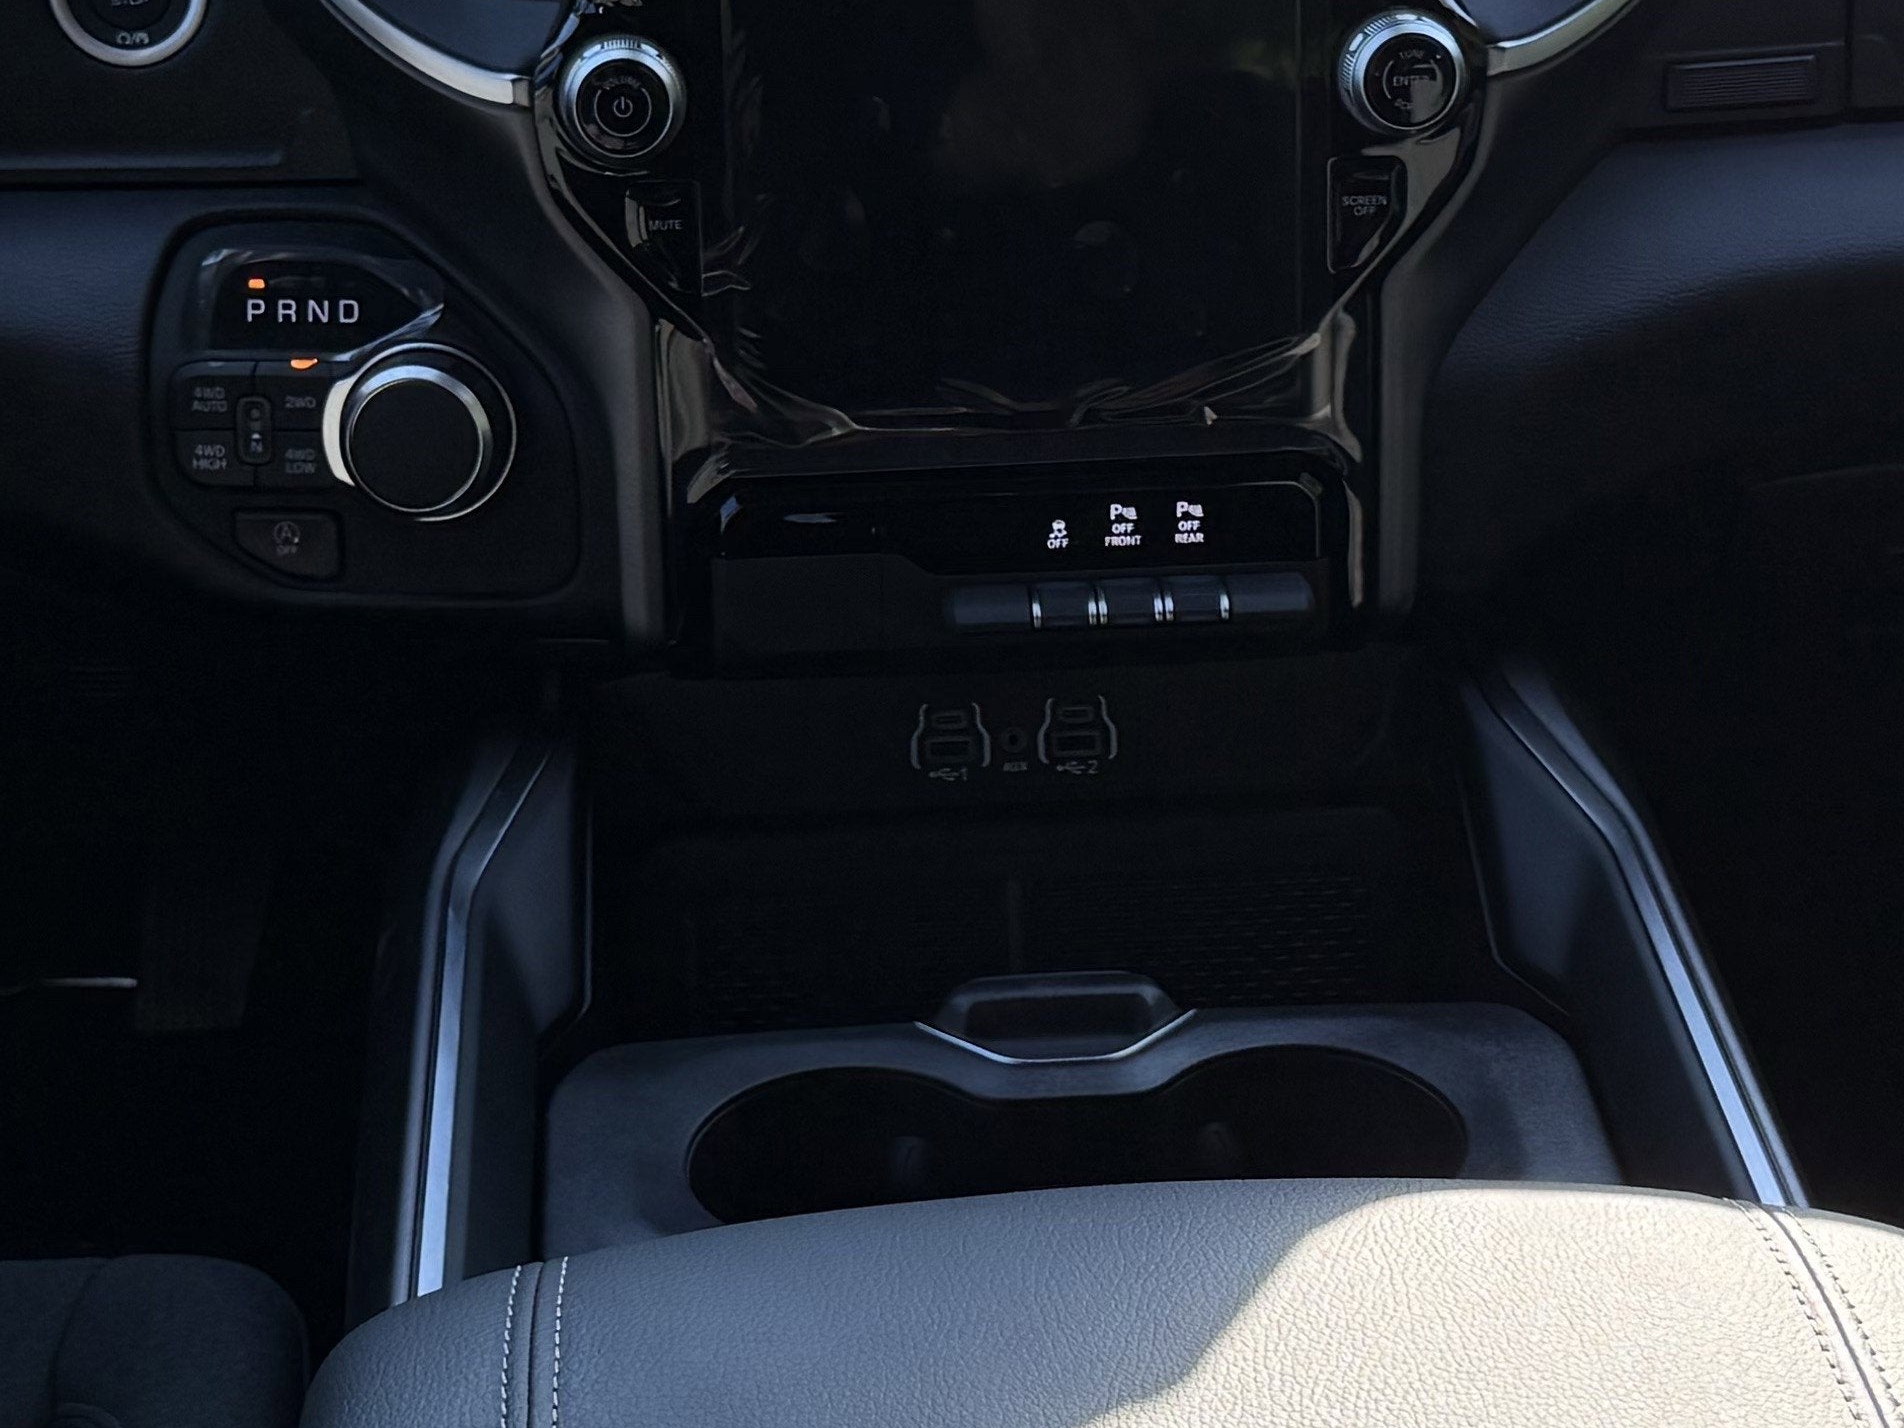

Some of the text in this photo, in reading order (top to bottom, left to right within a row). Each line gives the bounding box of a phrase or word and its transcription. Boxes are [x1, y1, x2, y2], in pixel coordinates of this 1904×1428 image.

[1342, 195, 1387, 206] SCREEN
[1353, 206, 1376, 216] OFF
[648, 219, 684, 231] MUTE
[191, 400, 228, 412] AUTO
[195, 444, 226, 458] 4WD
[192, 458, 227, 470] HIGH
[1111, 522, 1135, 534] OFF
[1178, 520, 1201, 531] OFF
[1046, 538, 1069, 549] OFF
[1104, 535, 1142, 547] FRONT
[1174, 532, 1205, 544] REAR
